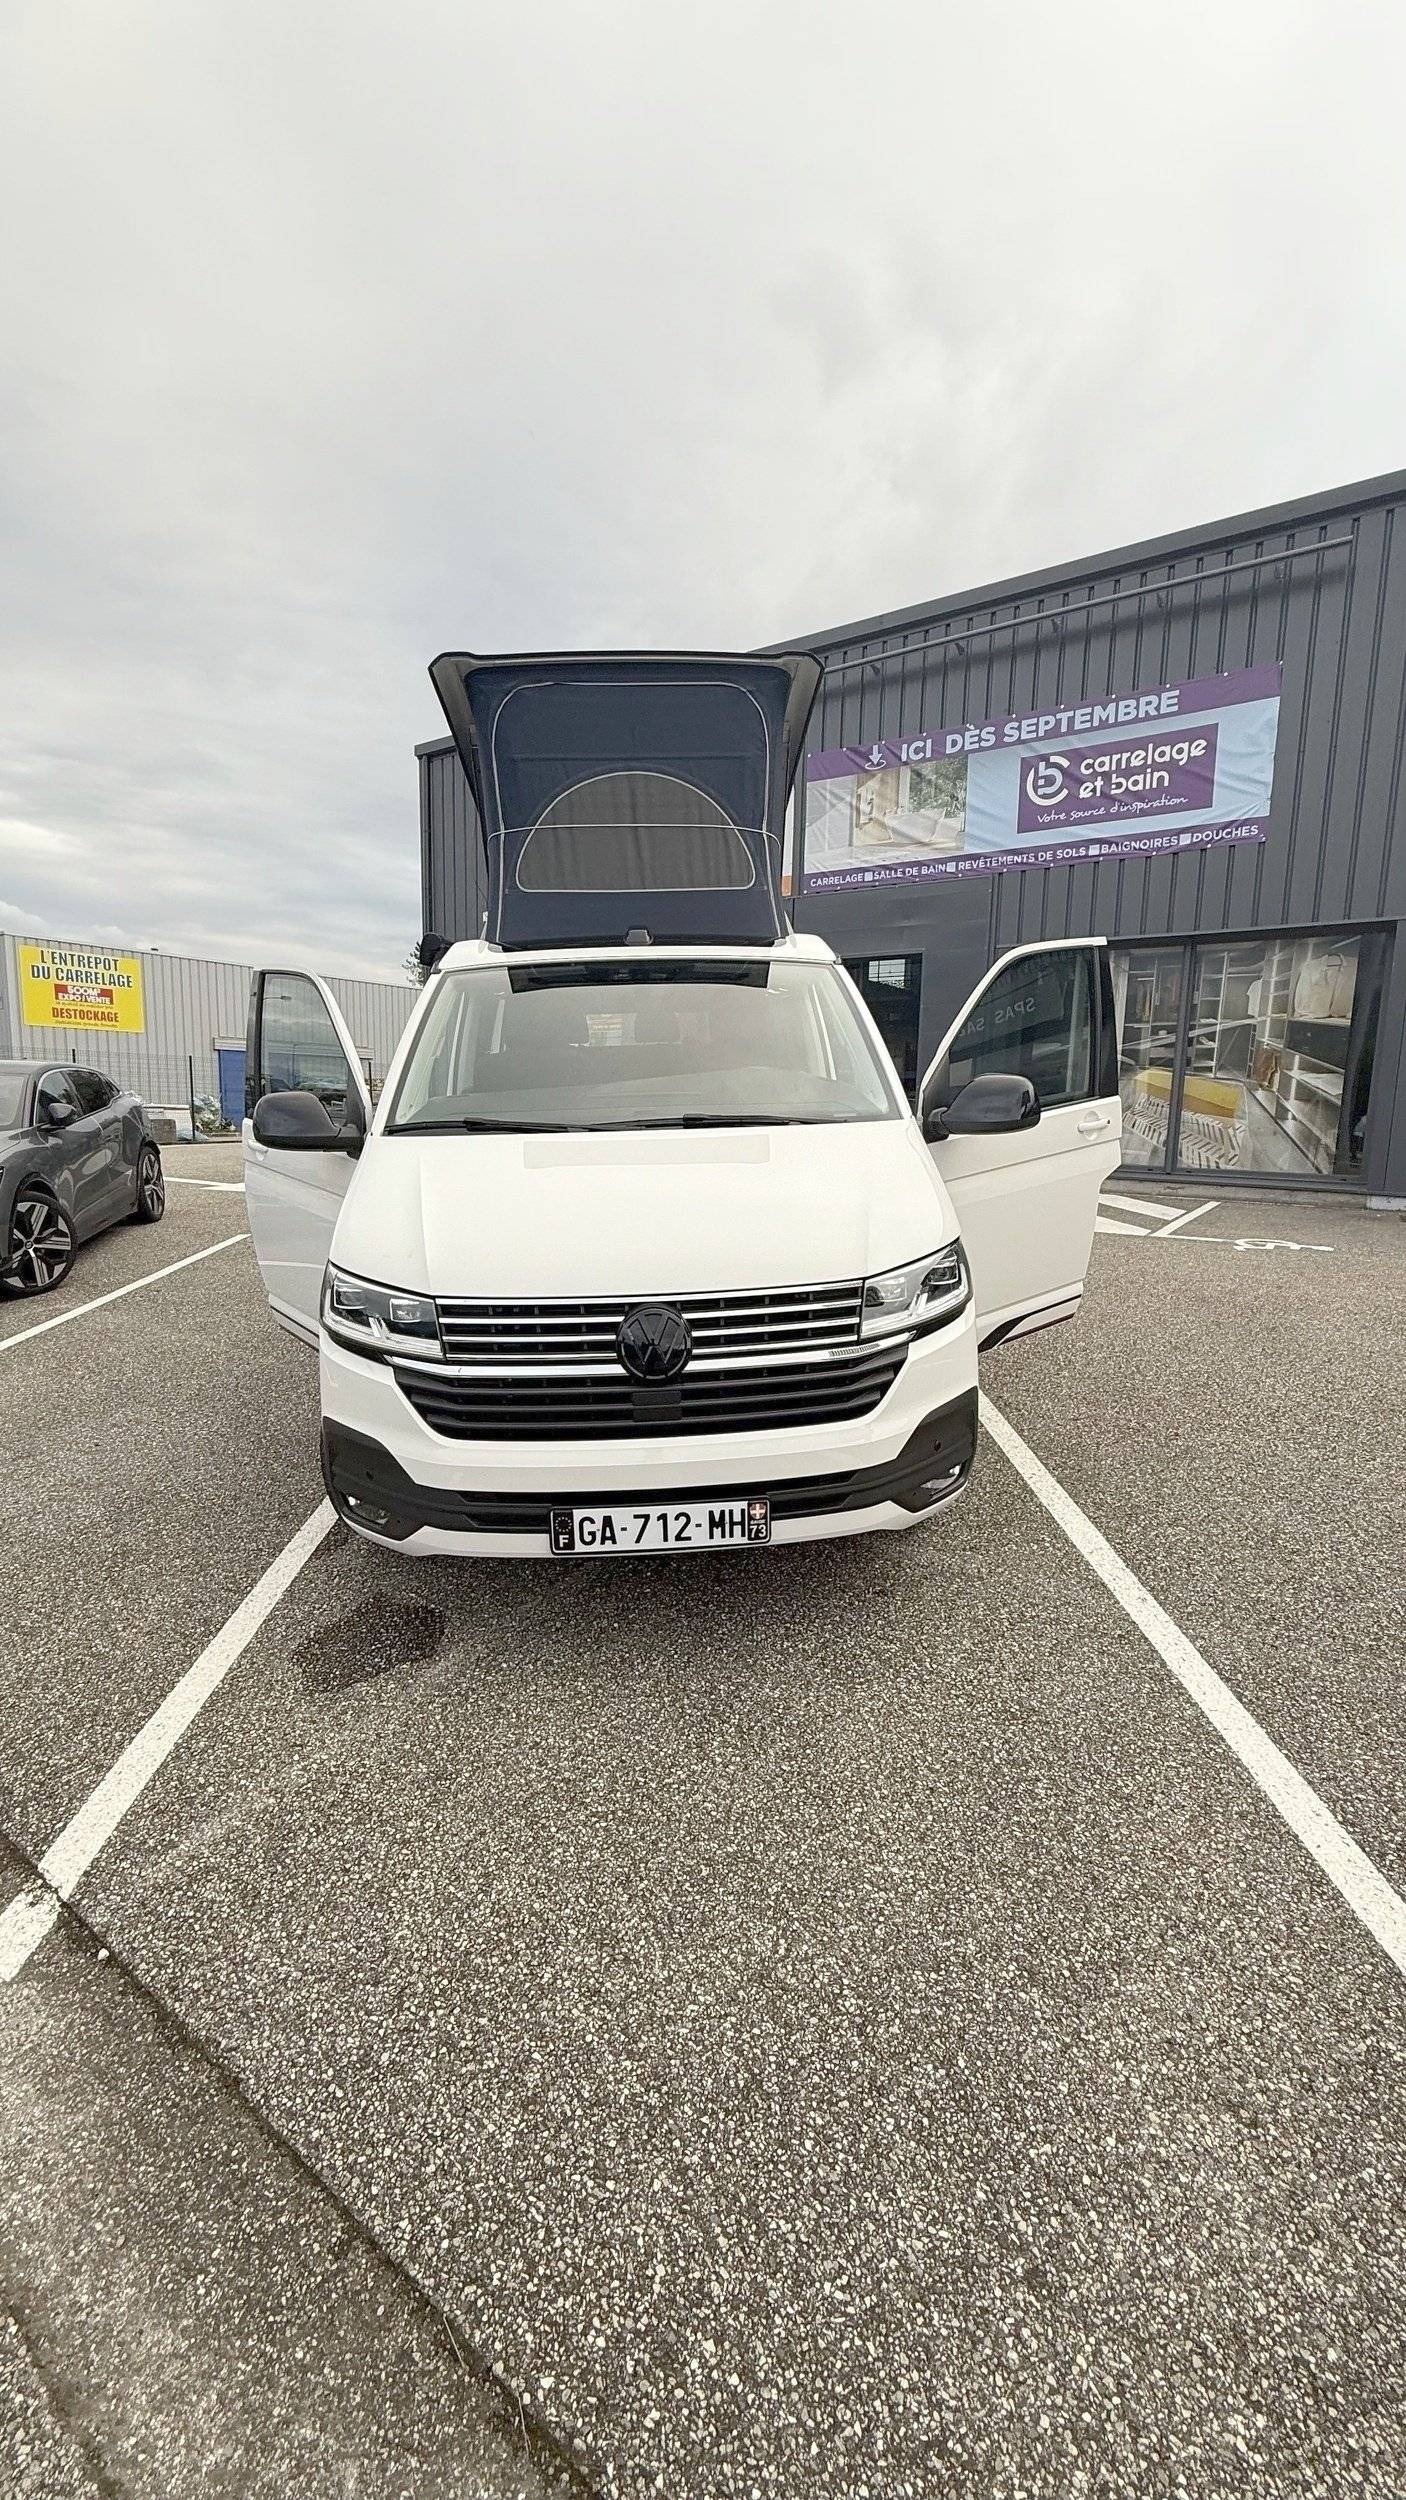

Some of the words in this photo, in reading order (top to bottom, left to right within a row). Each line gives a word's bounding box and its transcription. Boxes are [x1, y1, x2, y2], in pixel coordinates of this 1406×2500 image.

[901, 739, 932, 762] ICI
[945, 725, 996, 754] DÈS
[1003, 690, 1180, 743] SEPTEMBRE
[1080, 739, 1208, 775] carrelage
[1079, 776, 1104, 799] et
[1110, 768, 1170, 795] bain
[1070, 807, 1106, 821] source
[1110, 793, 1189, 815] d'inspiration
[810, 873, 864, 887] CARRELAGE
[873, 868, 903, 880] SALLE
[905, 866, 919, 876] DE
[921, 864, 948, 875] BAIN
[958, 853, 1036, 871] REVÊTEMENTS
[1037, 851, 1053, 861] DE
[1056, 846, 1086, 859] SOLS
[1101, 836, 1179, 854] BAIGNOIRES
[1192, 824, 1259, 843] DOUCHES
[40, 950, 119, 971] L'ENTREPOT
[31, 964, 51, 979] DU
[55, 967, 133, 988] CARRELAGE
[86, 995, 111, 1005] VENTE
[52, 1006, 119, 1023] DESTOCKAGE
[578, 1508, 746, 1546] GA-712-MH
[749, 1524, 767, 1538] 73
[559, 1534, 569, 1548] F
